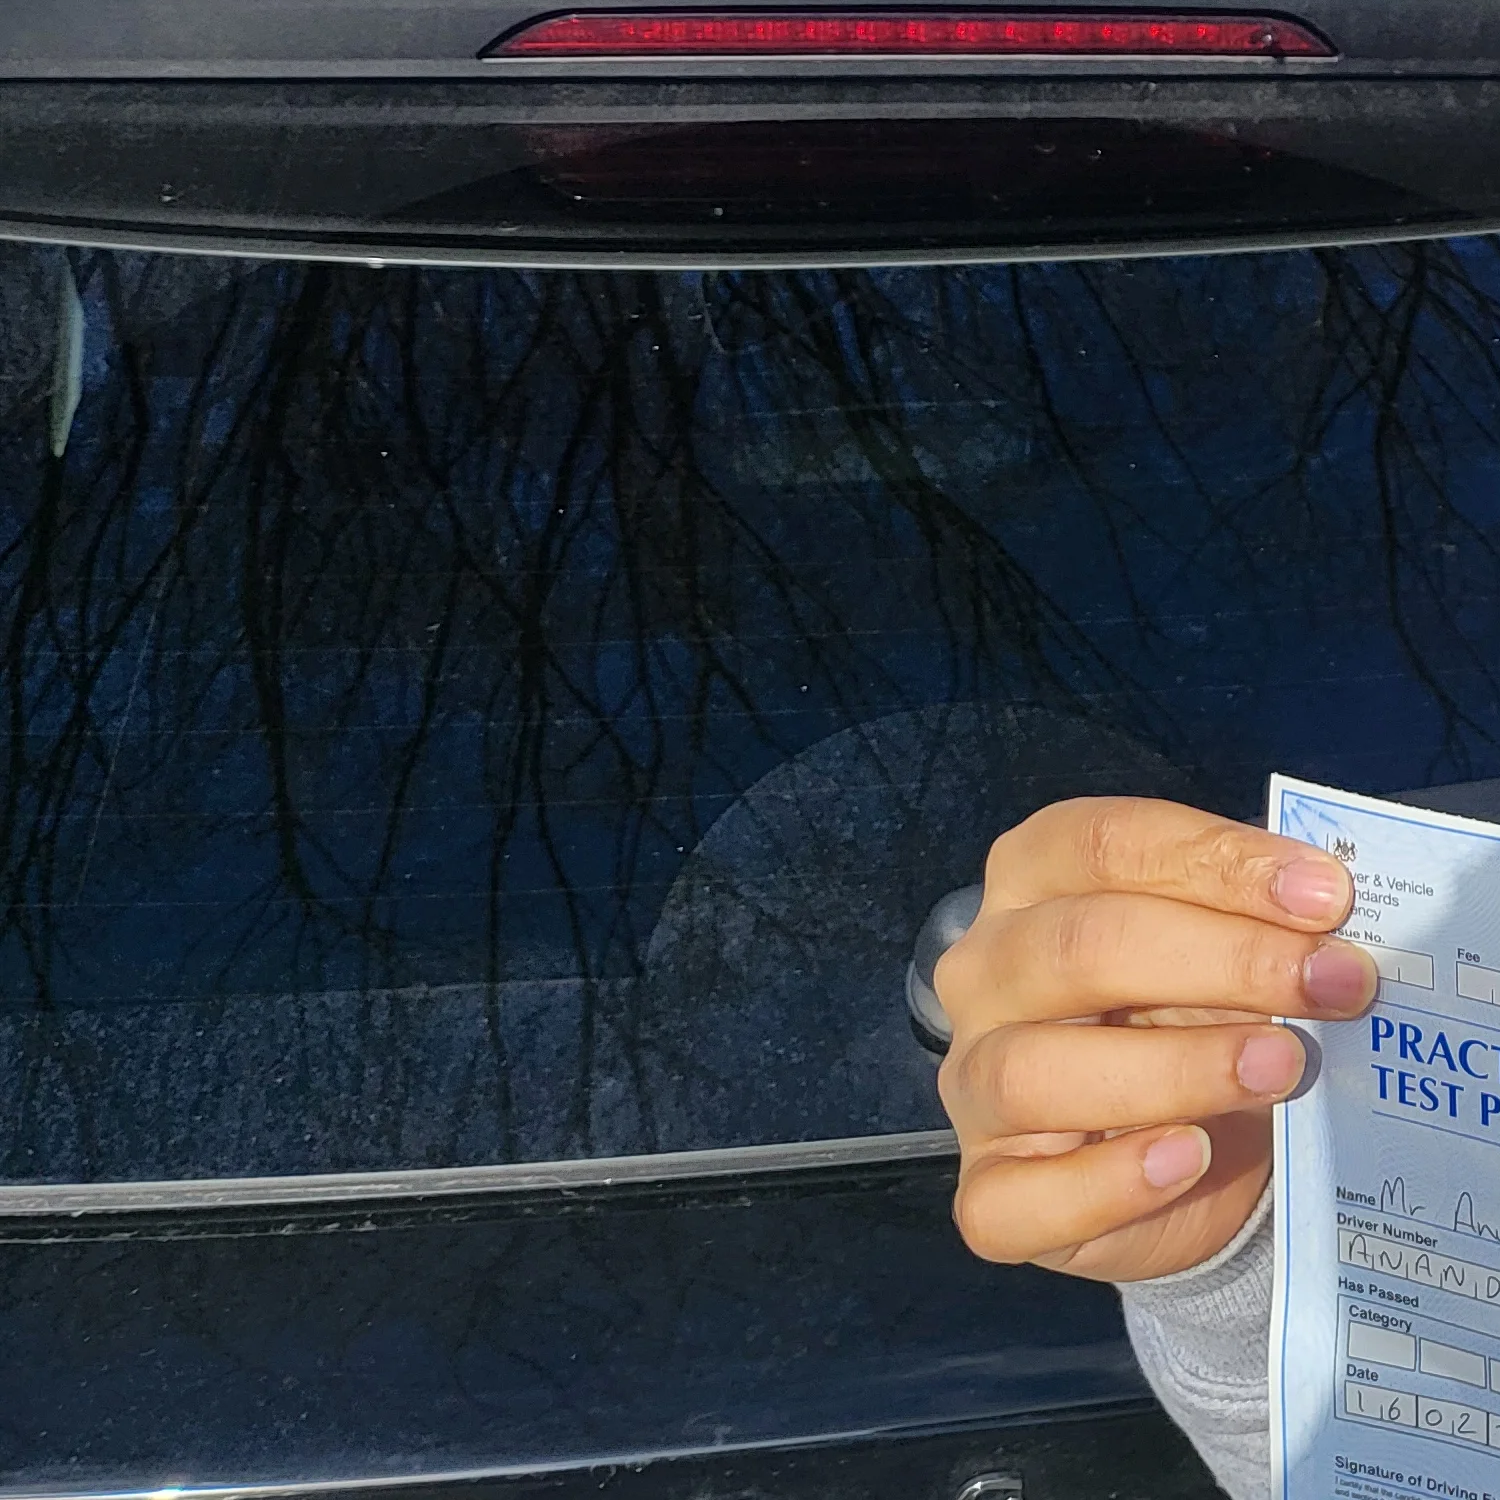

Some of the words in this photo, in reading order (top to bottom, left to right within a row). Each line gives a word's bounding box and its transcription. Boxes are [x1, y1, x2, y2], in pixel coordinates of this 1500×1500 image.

[1373, 874, 1383, 887] &
[1386, 876, 1434, 897] Vehicle
[1364, 930, 1385, 944] No.
[1457, 948, 1480, 962] Fee
[1371, 1064, 1464, 1118] TEST
[1336, 1186, 1376, 1206] Name
[1380, 1176, 1426, 1215] Mr
[1337, 1212, 1378, 1232] Driver
[1383, 1222, 1438, 1247] Number
[1338, 1276, 1364, 1293] Has
[1369, 1284, 1419, 1308] Passed
[1349, 1305, 1412, 1332] Category
[1346, 1364, 1379, 1382] Date
[1335, 1455, 1403, 1483] Signature
[1408, 1475, 1422, 1488] of
[1427, 1478, 1478, 1500] Driving
